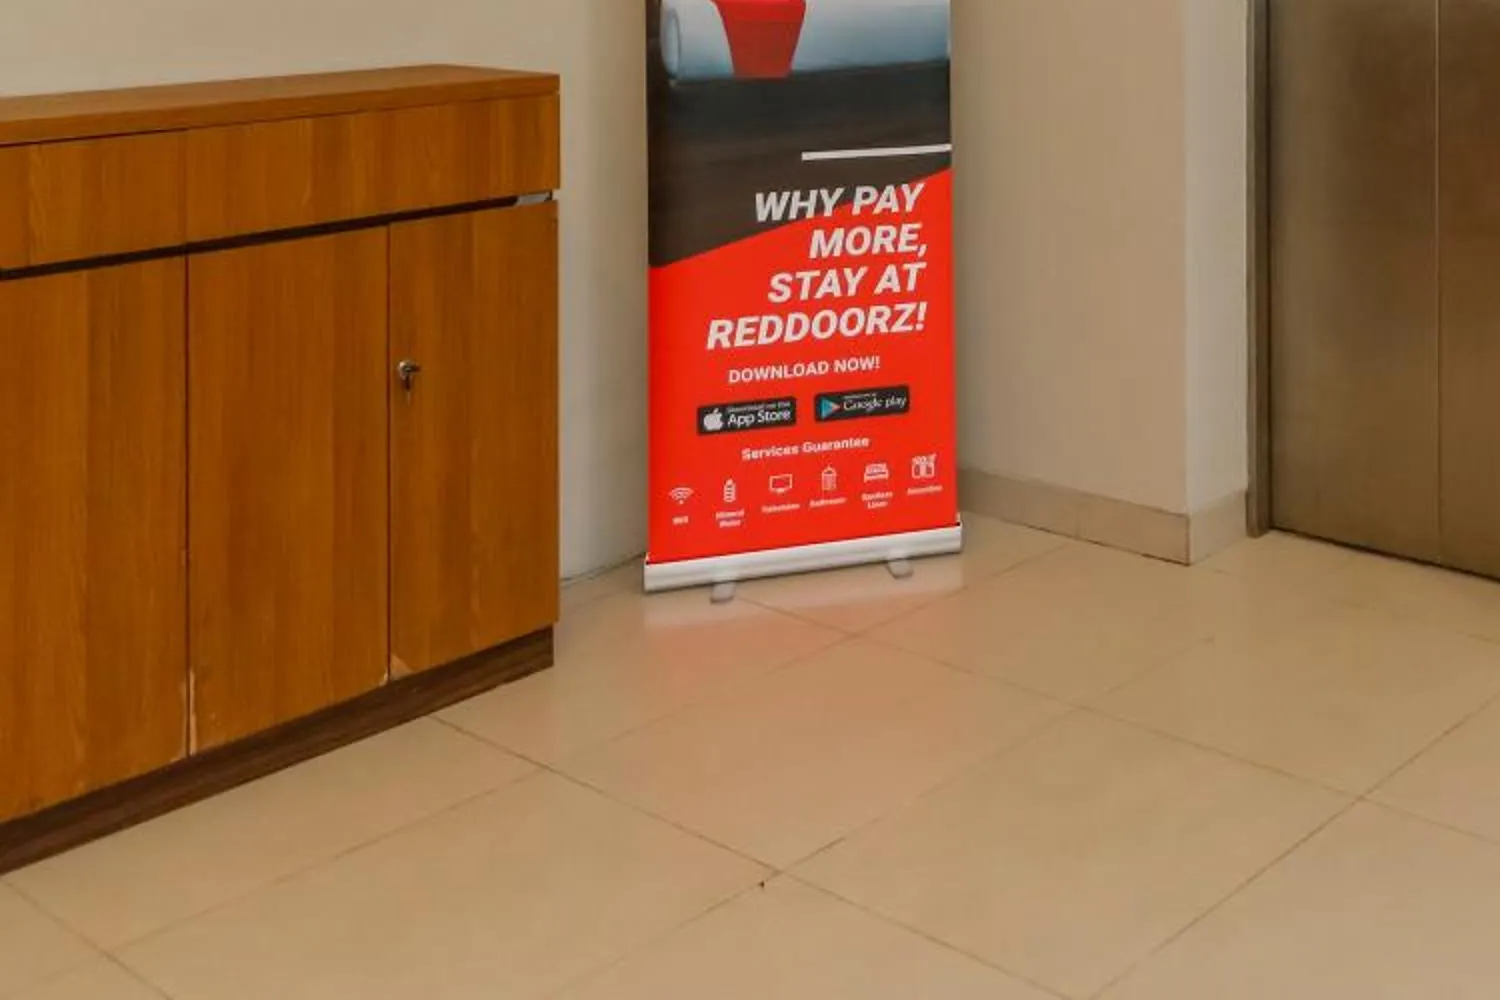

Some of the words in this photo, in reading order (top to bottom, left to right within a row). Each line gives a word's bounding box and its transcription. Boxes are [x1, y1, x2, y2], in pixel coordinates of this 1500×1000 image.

[755, 187, 843, 222] WHY
[851, 183, 925, 216] PAY
[808, 222, 928, 259] MORE,
[768, 266, 868, 304] STAY
[874, 261, 927, 295] AT
[706, 301, 928, 350] REDDOORZ!
[728, 363, 829, 384] DOWNLOAD
[834, 355, 880, 373] NOW!
[727, 413, 754, 427] App
[757, 409, 791, 423] Store
[885, 396, 907, 409] play
[741, 446, 799, 461] Services
[802, 436, 870, 453] Guarantee
